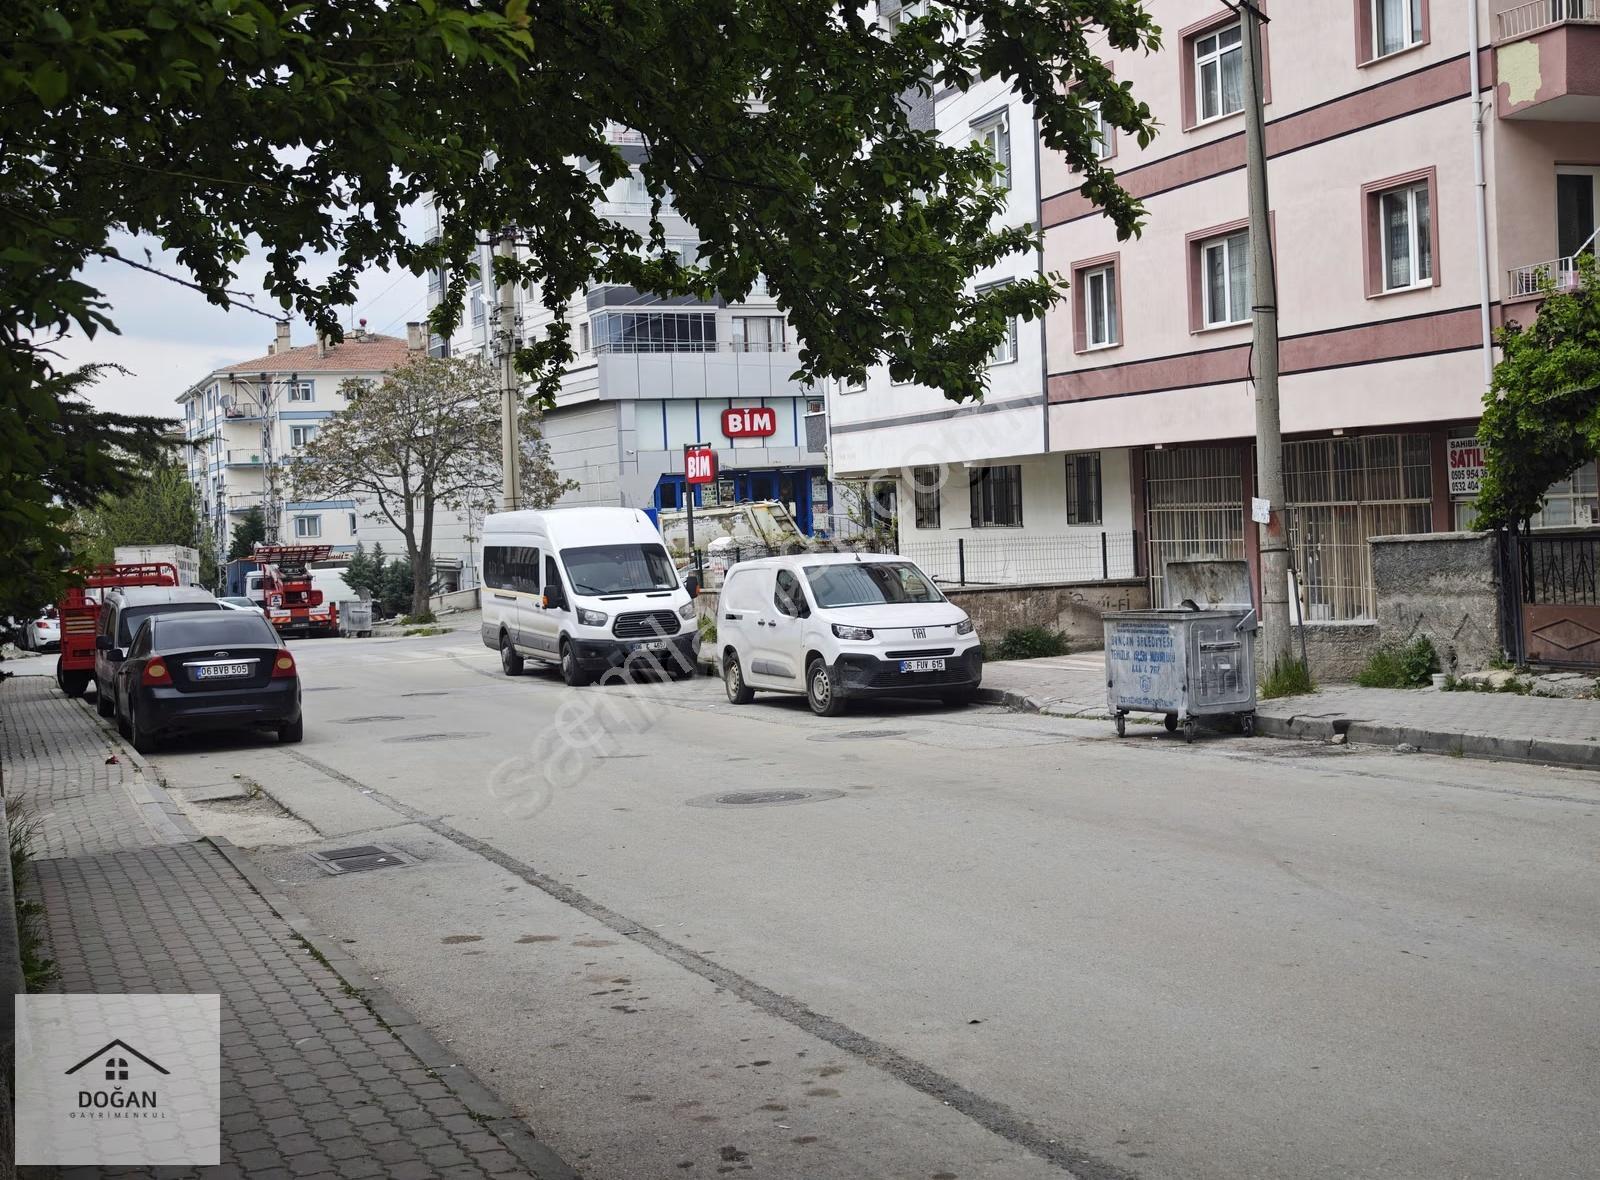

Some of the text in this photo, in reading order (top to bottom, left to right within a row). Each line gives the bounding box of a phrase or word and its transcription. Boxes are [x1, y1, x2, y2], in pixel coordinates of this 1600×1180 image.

[728, 409, 771, 432] BİM
[687, 451, 711, 479] BİM
[1450, 448, 1486, 469] SATIL
[911, 628, 927, 639] FIAT
[201, 665, 247, 676] 06 BVB 505
[904, 661, 912, 670] 06
[931, 660, 943, 669] 615
